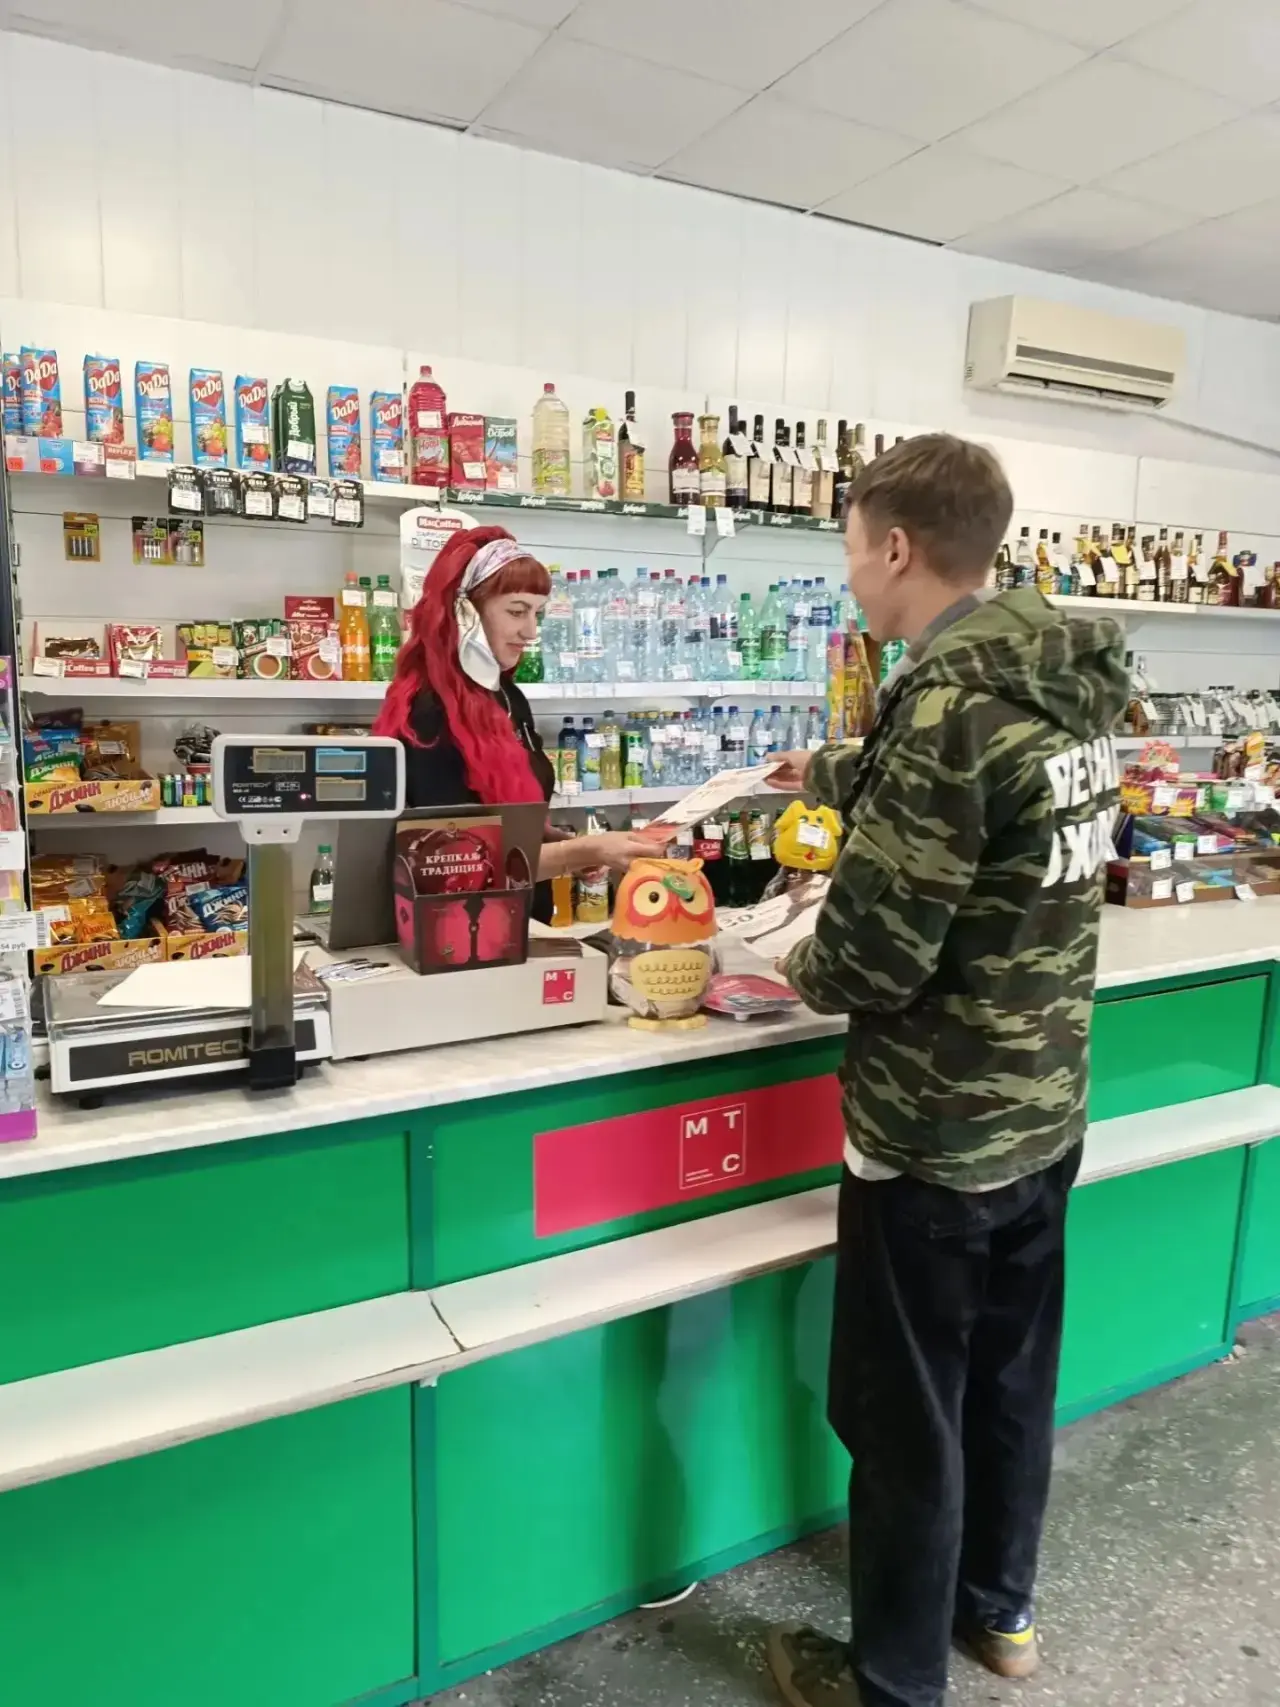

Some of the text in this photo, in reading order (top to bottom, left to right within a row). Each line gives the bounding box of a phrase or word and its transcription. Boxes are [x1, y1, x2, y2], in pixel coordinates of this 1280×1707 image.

[89, 370, 120, 392] DaDa
[192, 380, 222, 402] DaDa
[239, 386, 267, 408] DaDa
[420, 863, 484, 877] ТРАДИЦИЯ
[425, 853, 480, 865] КРЕПКАЯ
